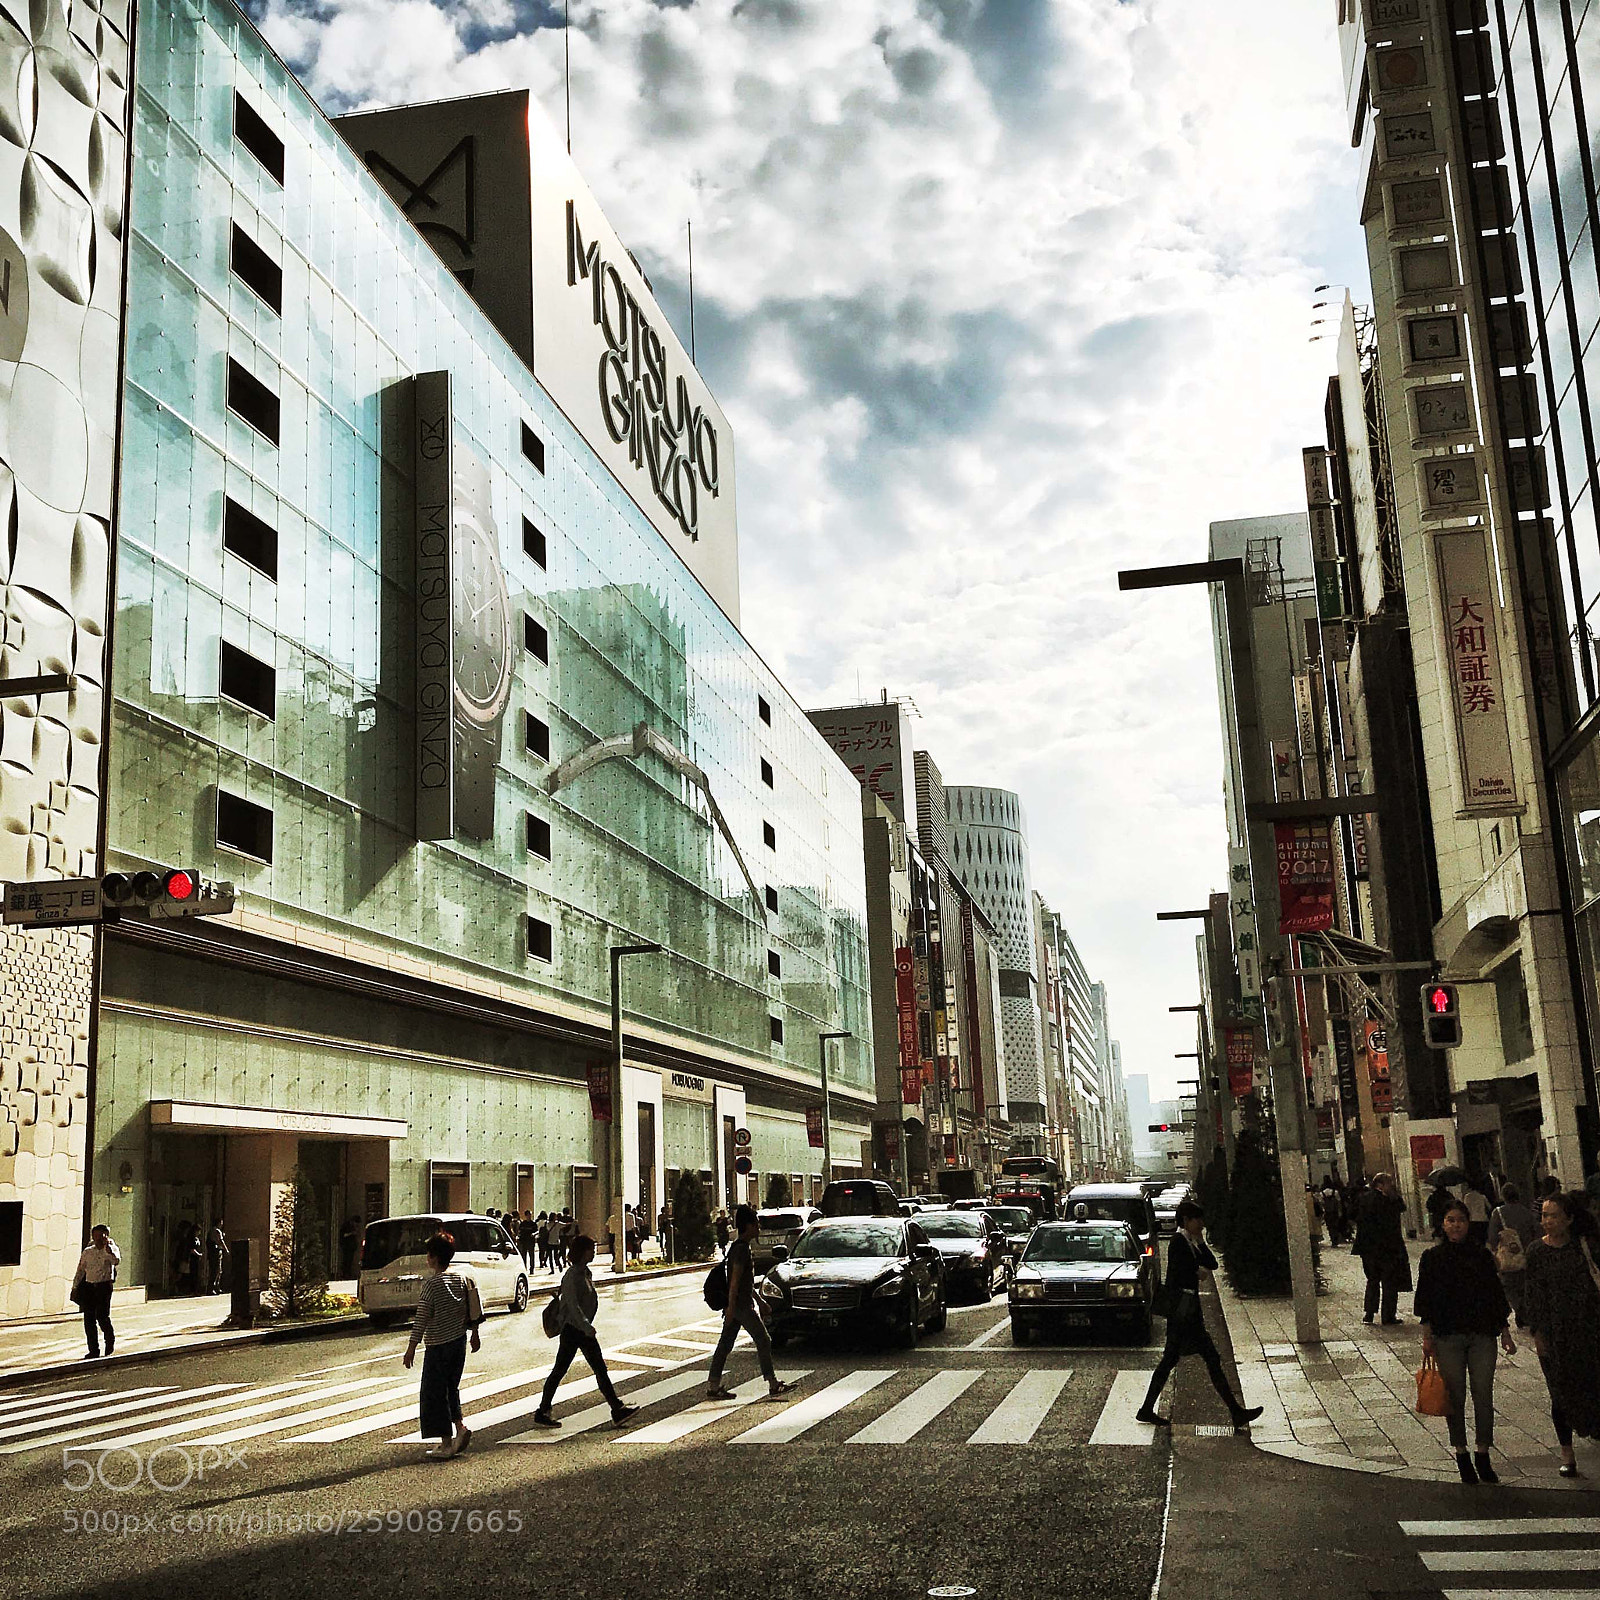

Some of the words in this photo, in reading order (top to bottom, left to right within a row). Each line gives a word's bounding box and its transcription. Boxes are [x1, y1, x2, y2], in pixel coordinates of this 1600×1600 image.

[1451, 596, 1496, 714] 大和証券
[817, 720, 893, 737] ニューアル
[1472, 785, 1512, 797] Securities
[1478, 778, 1504, 788] Daiwa
[1278, 851, 1316, 860] GINZA
[1279, 860, 1329, 876] 2017
[10, 890, 95, 911] 銀座二丁目
[35, 910, 60, 919] Ginza
[63, 908, 69, 917] 2
[963, 903, 974, 962] MITSUKOSHI
